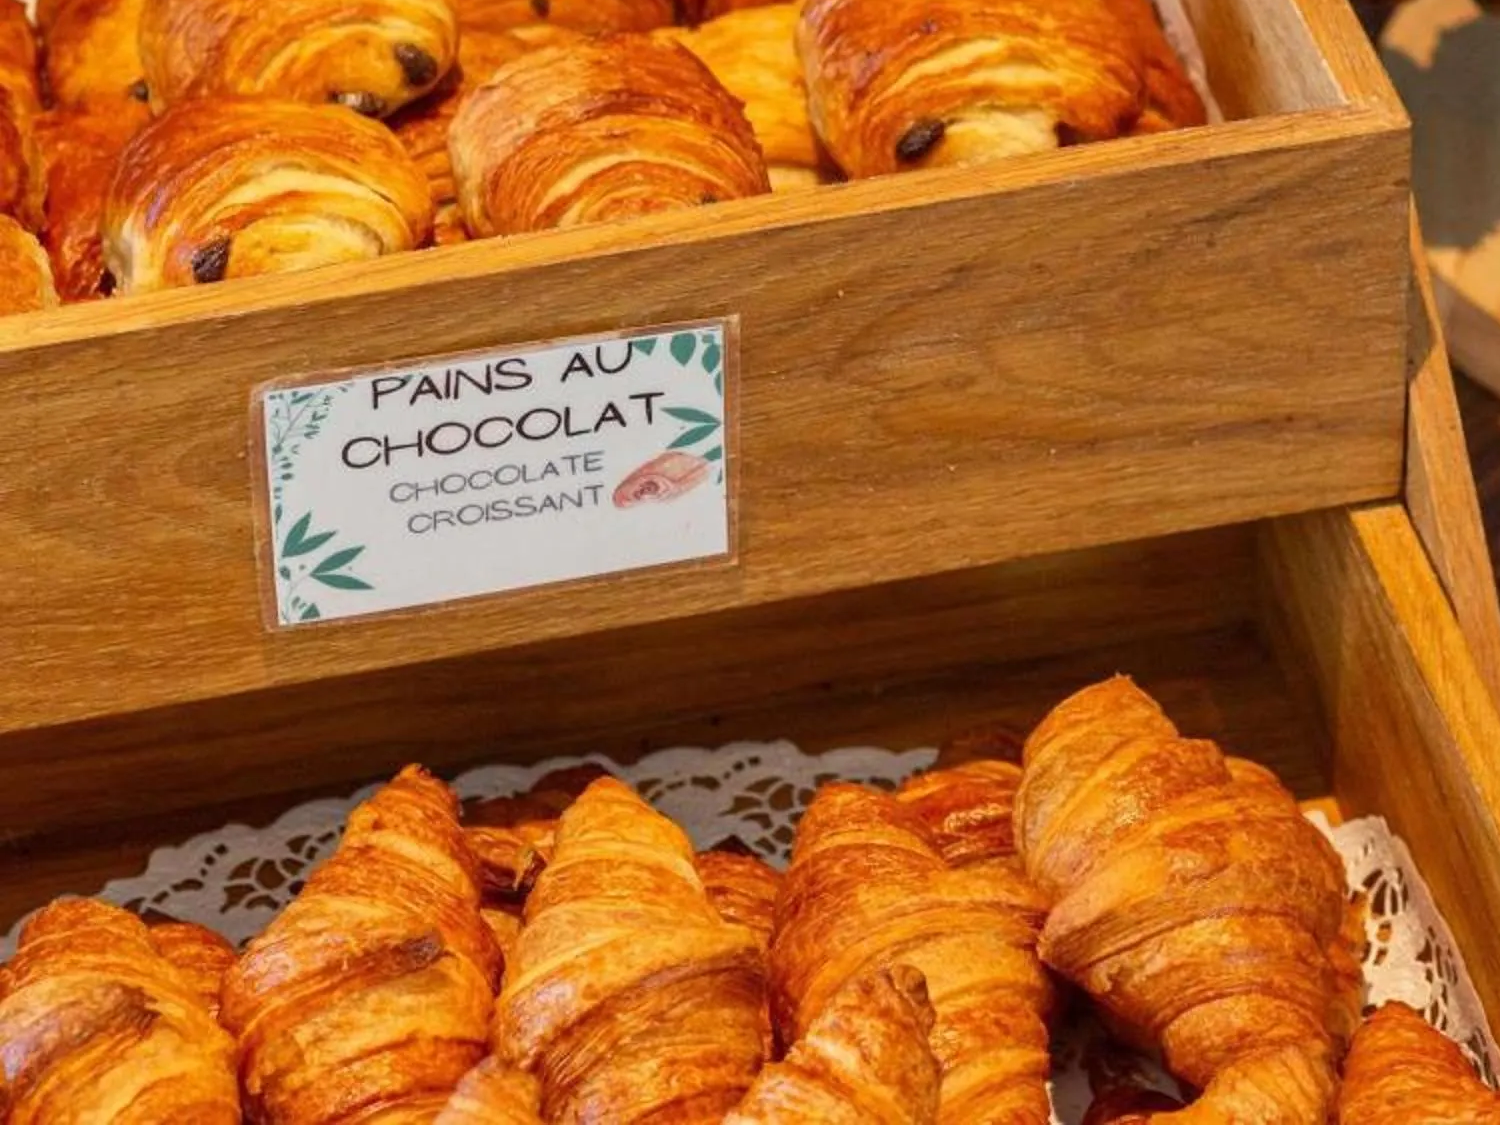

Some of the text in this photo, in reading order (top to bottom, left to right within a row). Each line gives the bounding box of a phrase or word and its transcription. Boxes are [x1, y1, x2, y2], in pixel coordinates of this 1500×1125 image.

[372, 341, 633, 409] PAINS AU
[341, 392, 665, 469] CHOCOLAT
[389, 450, 607, 504] CHOCOLATE
[407, 484, 604, 535] CROISSANT
